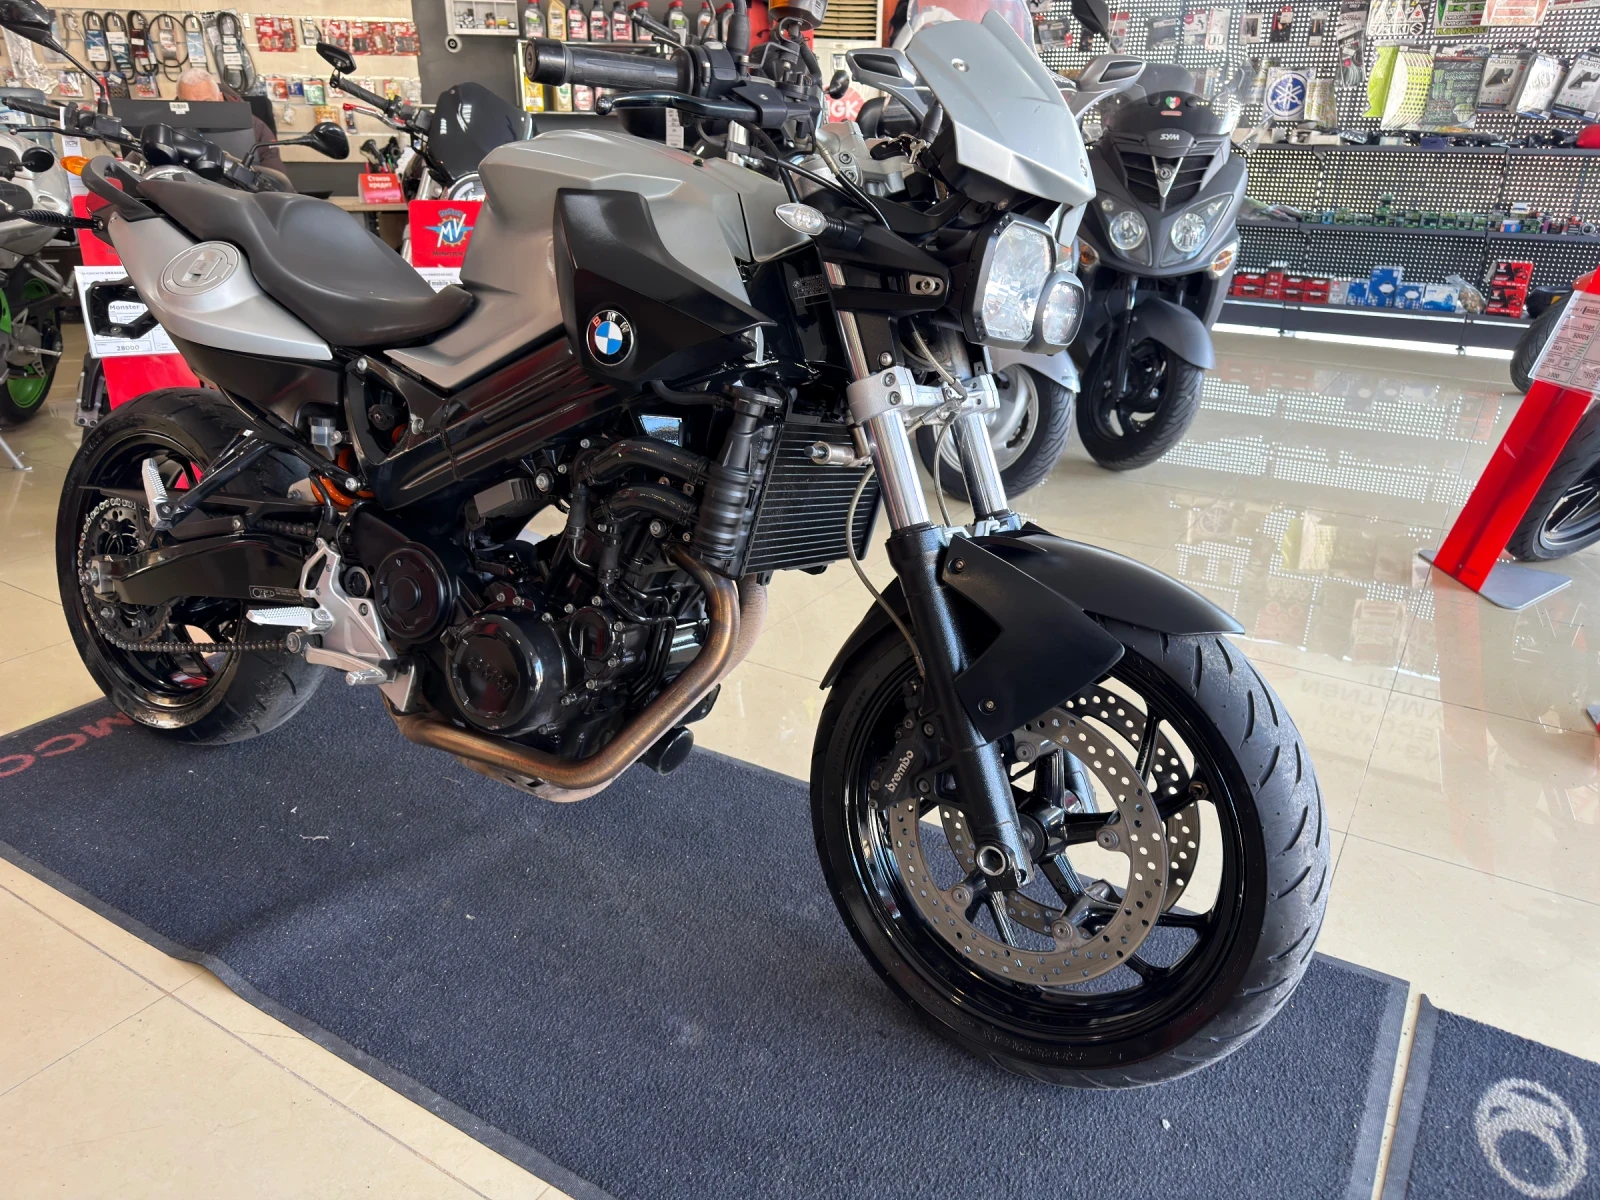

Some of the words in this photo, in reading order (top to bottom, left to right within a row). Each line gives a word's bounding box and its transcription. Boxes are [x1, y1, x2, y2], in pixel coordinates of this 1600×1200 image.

[1370, 25, 1409, 34] SUZUKI
[1436, 26, 1489, 35] Kawasaki
[436, 213, 467, 248] MV
[592, 311, 630, 333] BMW
[884, 750, 914, 793] brembo
